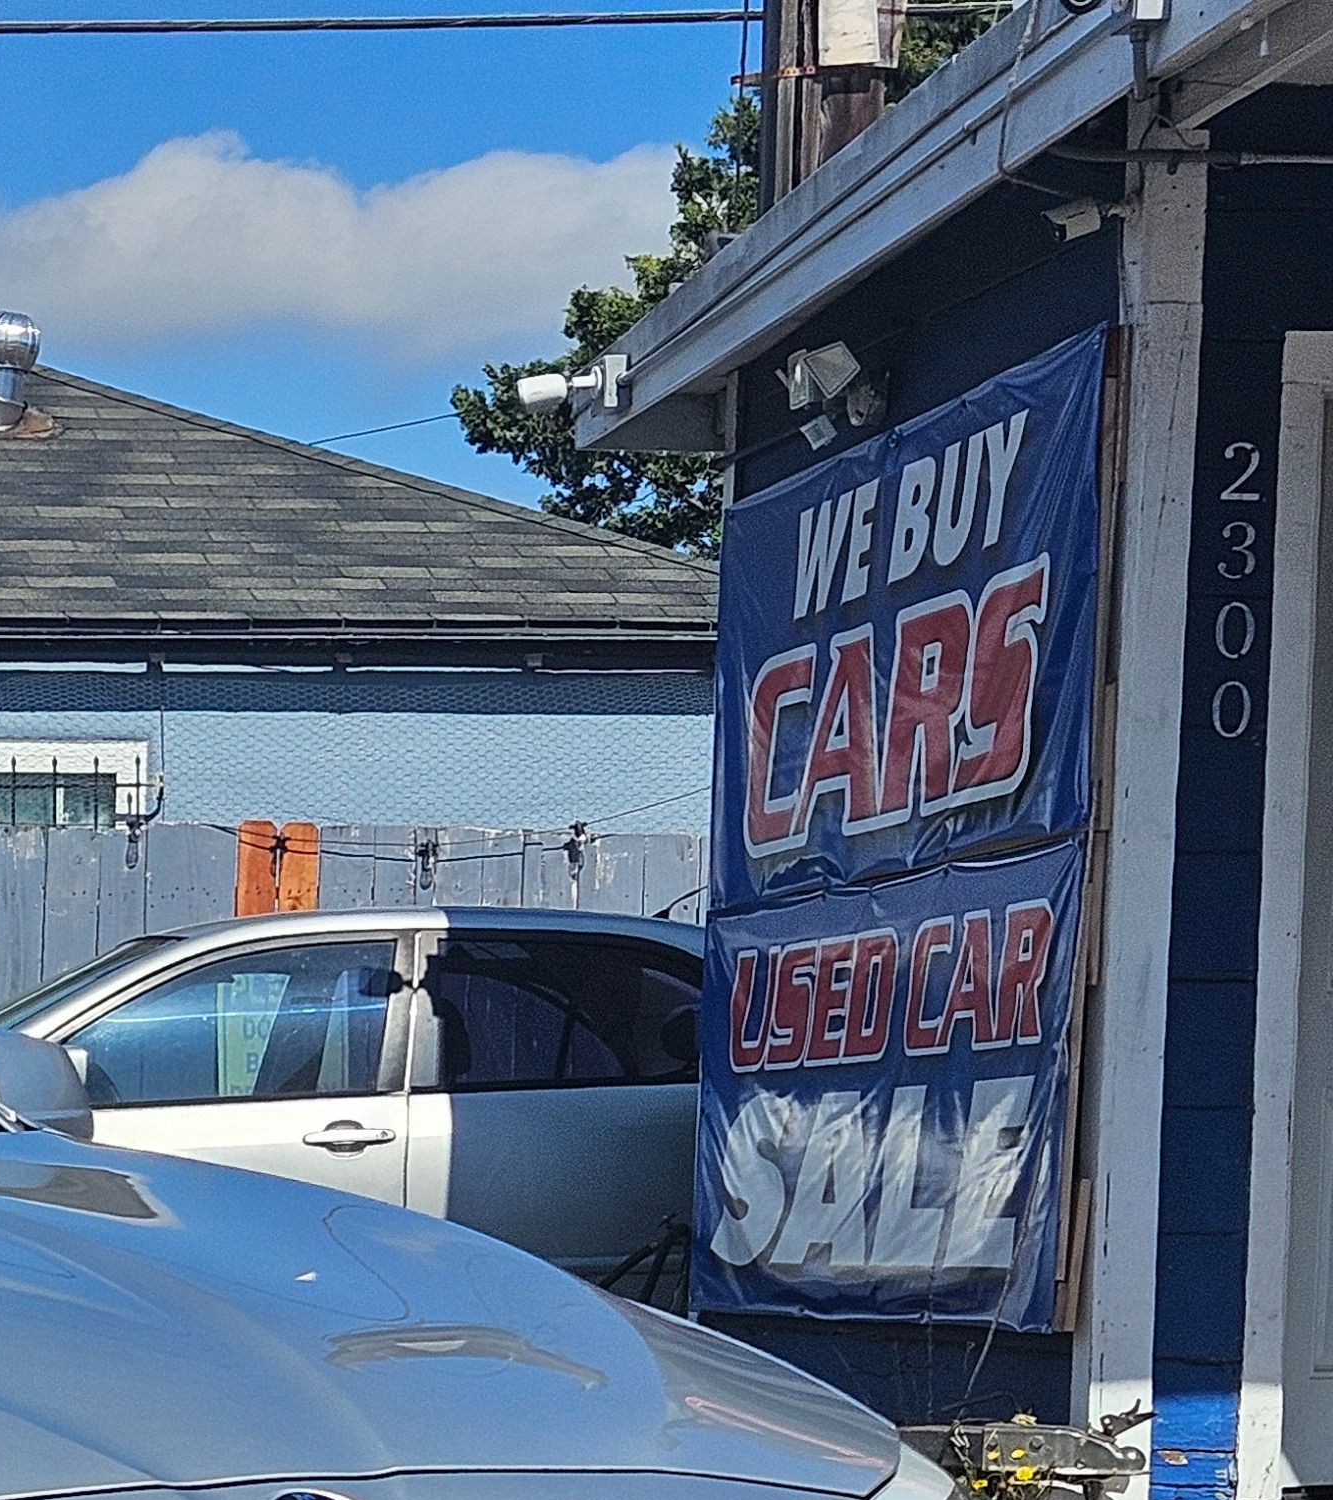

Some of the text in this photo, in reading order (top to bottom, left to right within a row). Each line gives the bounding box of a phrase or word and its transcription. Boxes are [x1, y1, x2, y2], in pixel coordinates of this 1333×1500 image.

[794, 409, 1029, 620] WE BUY
[1212, 442, 1261, 738] 2300
[744, 552, 1050, 858] CARS
[729, 898, 1055, 1072] USED CAR
[710, 1075, 1035, 1269] SALE
